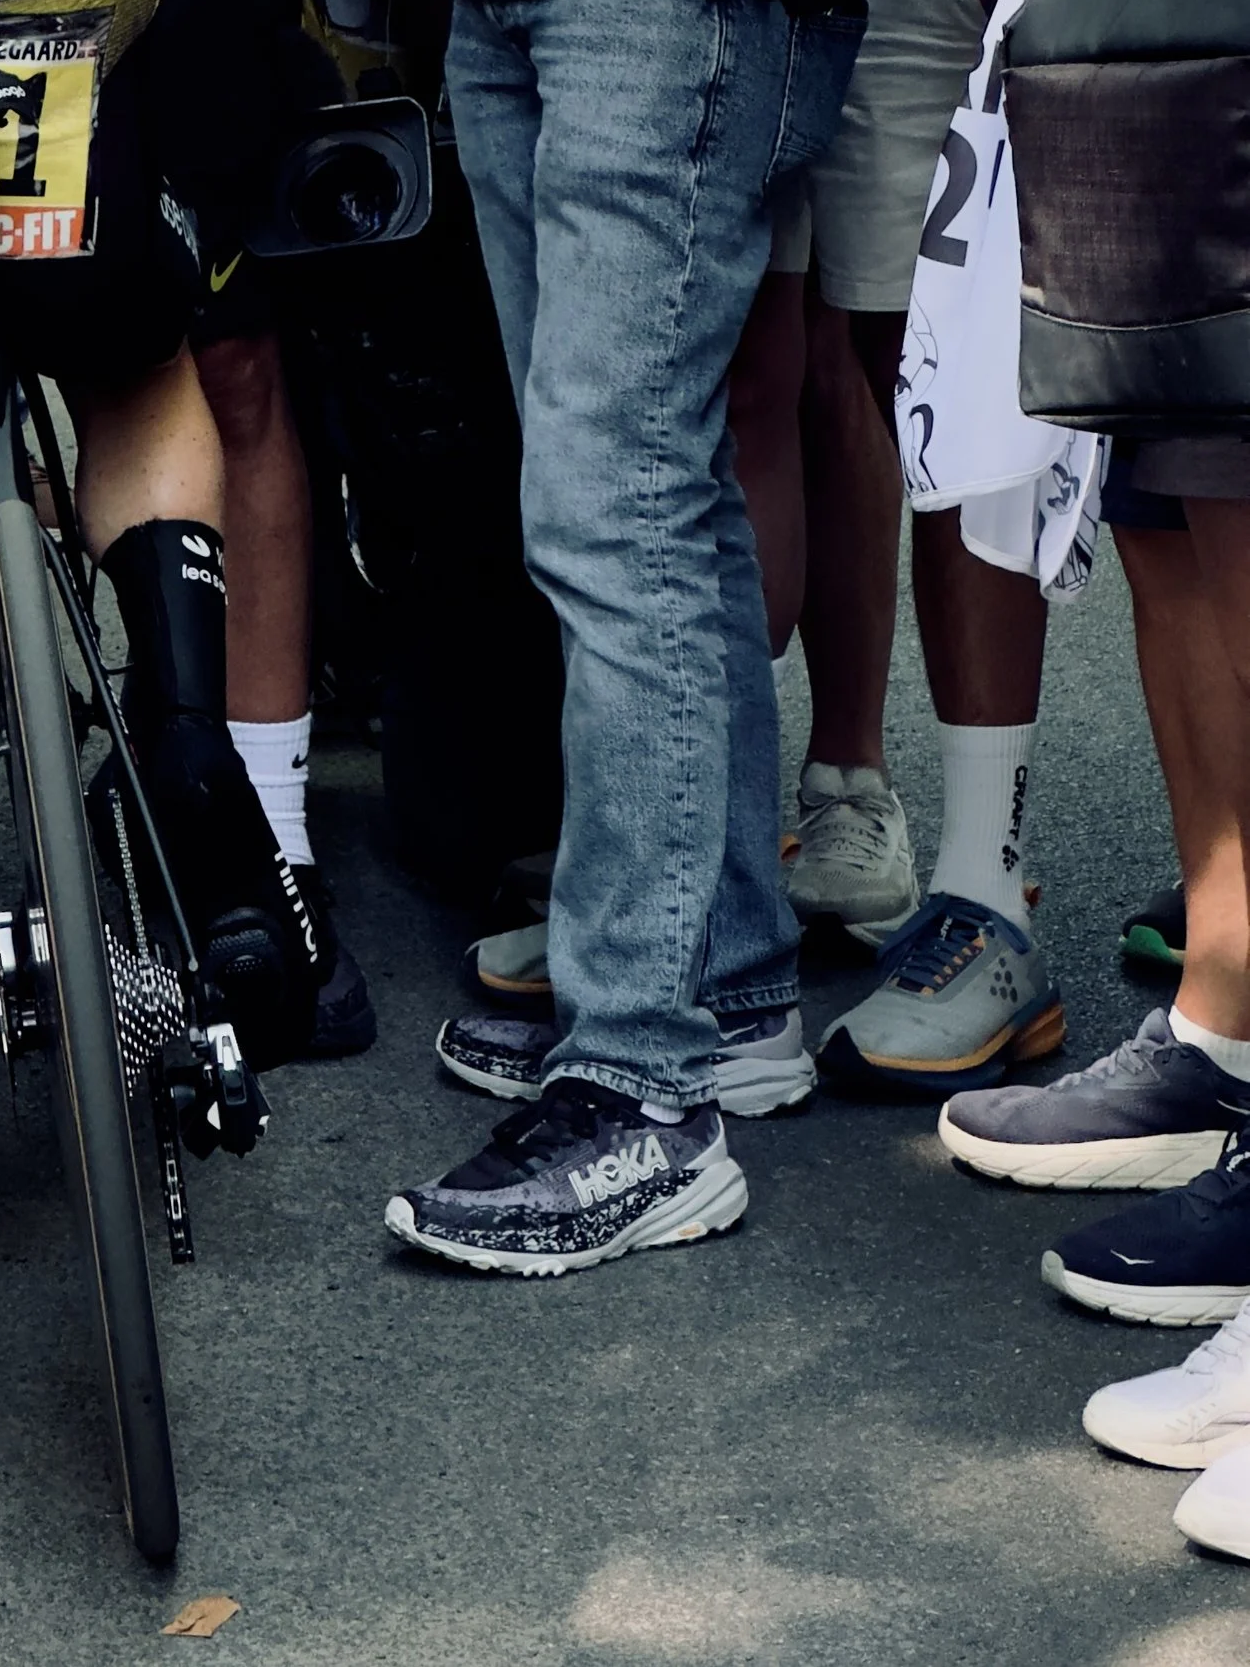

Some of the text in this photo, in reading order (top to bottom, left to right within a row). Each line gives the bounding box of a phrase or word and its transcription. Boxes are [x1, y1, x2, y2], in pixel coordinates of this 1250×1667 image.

[181, 563, 226, 594] lease
[1009, 764, 1029, 841] CRAFT
[567, 1133, 670, 1209] HOKA
